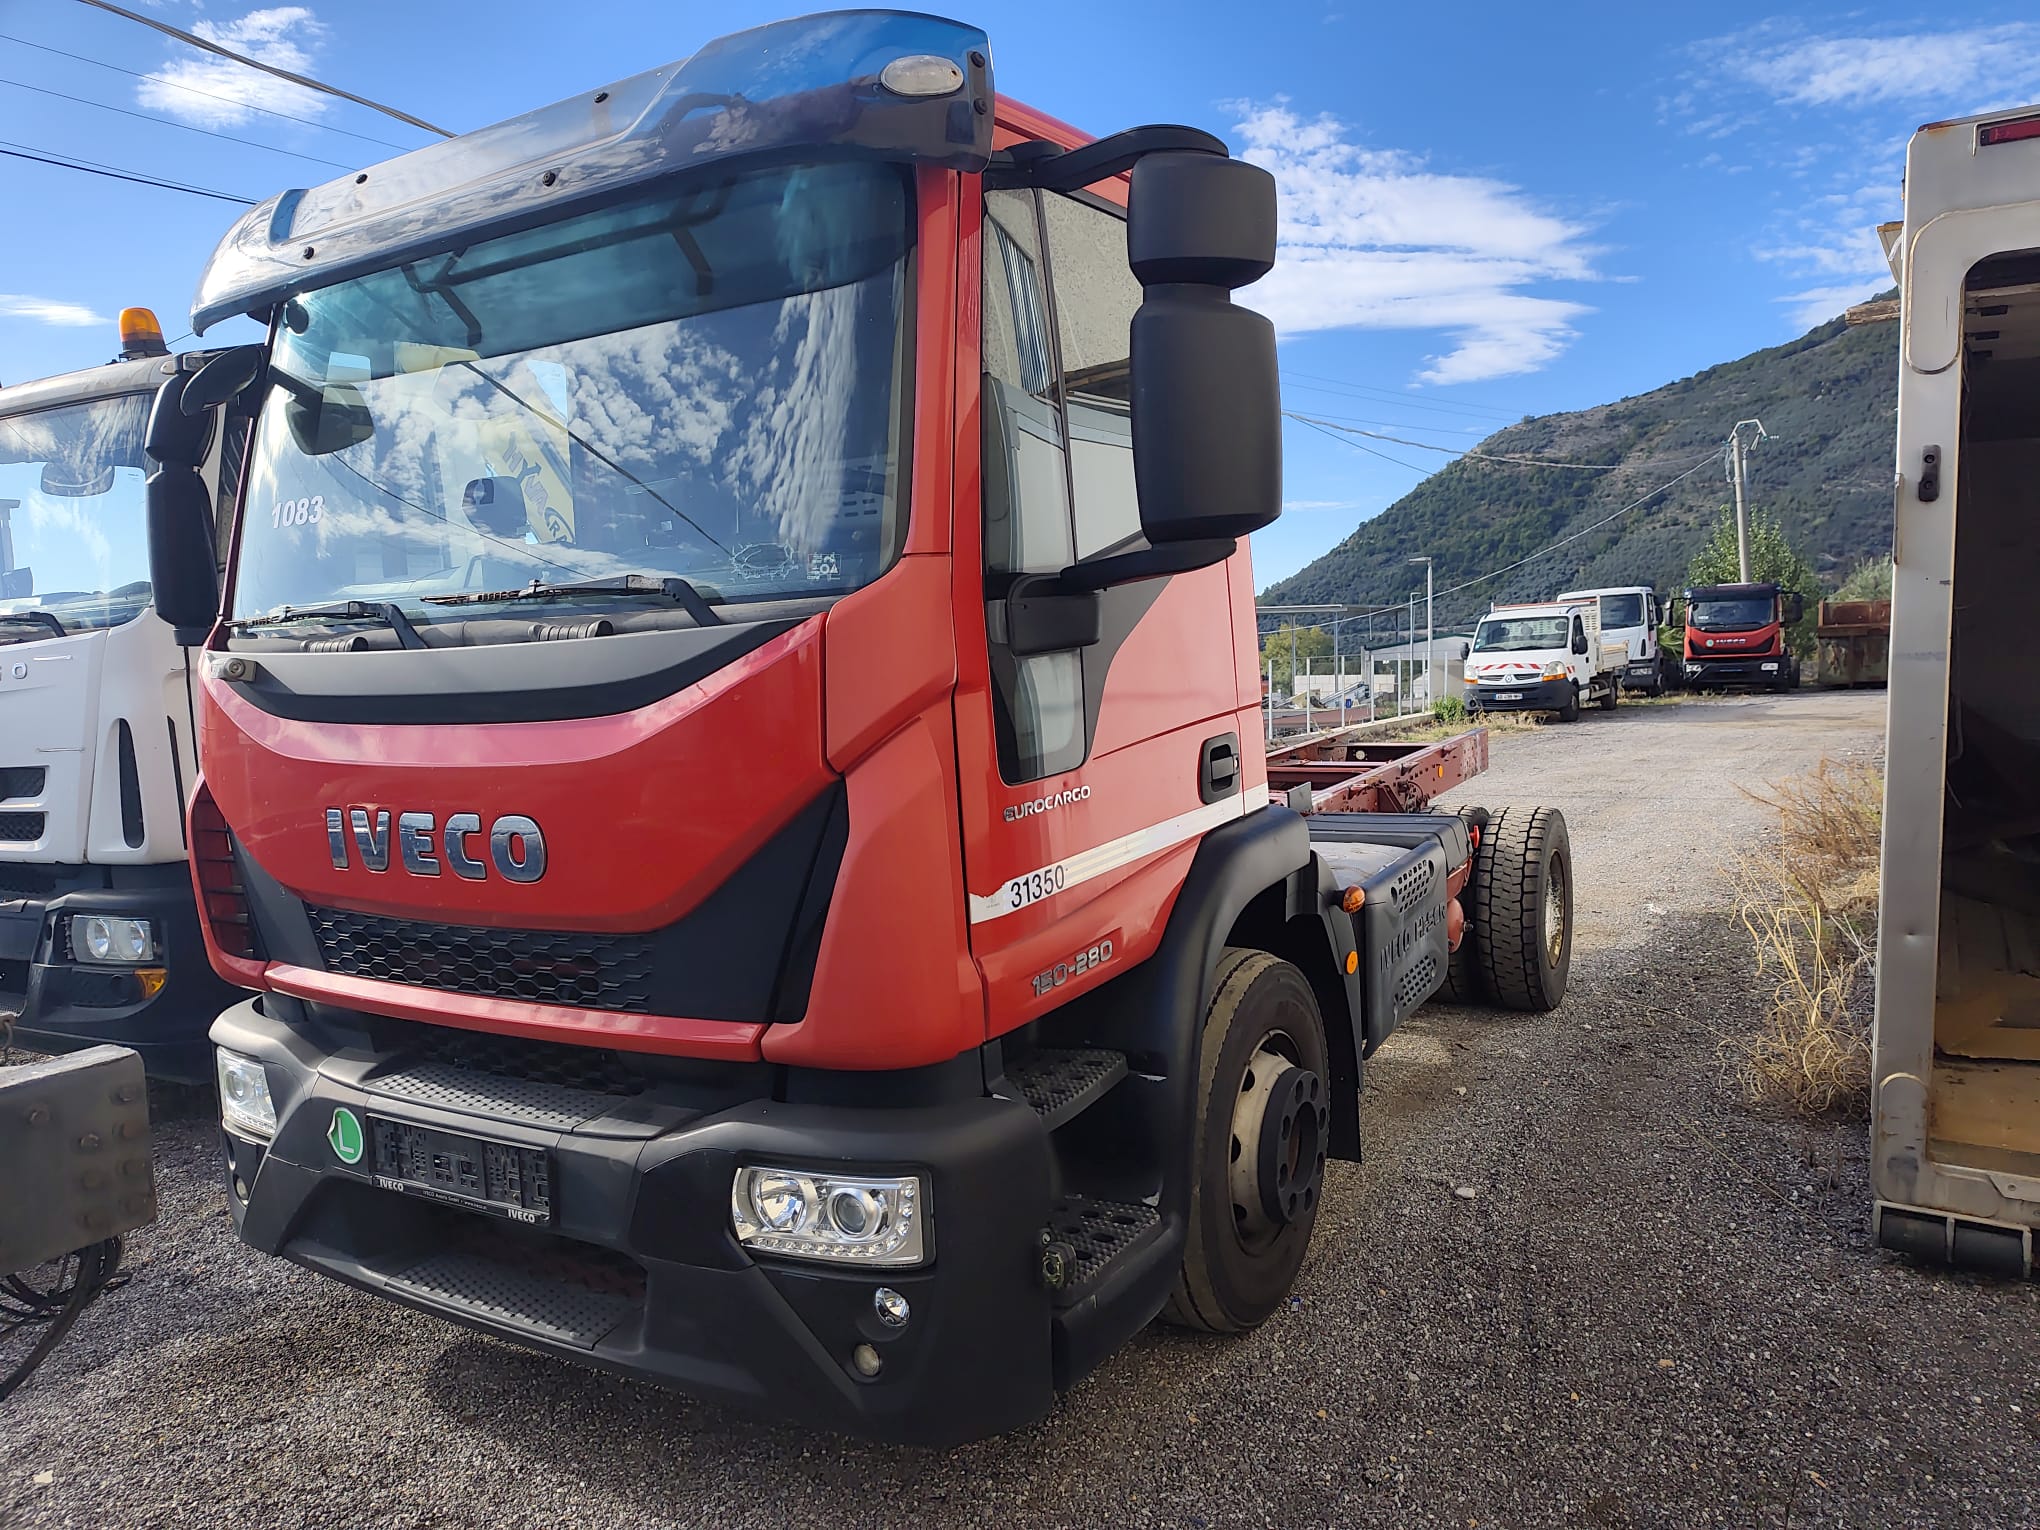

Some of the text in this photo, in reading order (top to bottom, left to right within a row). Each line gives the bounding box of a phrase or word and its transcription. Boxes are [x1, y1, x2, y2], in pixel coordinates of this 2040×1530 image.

[271, 495, 324, 529] 1083
[1003, 785, 1092, 822] EUROCARGO
[326, 807, 548, 884] IVECO
[1010, 864, 1065, 908] 31350
[1032, 939, 1114, 997] 150-280
[337, 1116, 355, 1155] L
[379, 1178, 404, 1193] IVECO
[507, 1207, 536, 1224] IVECO
